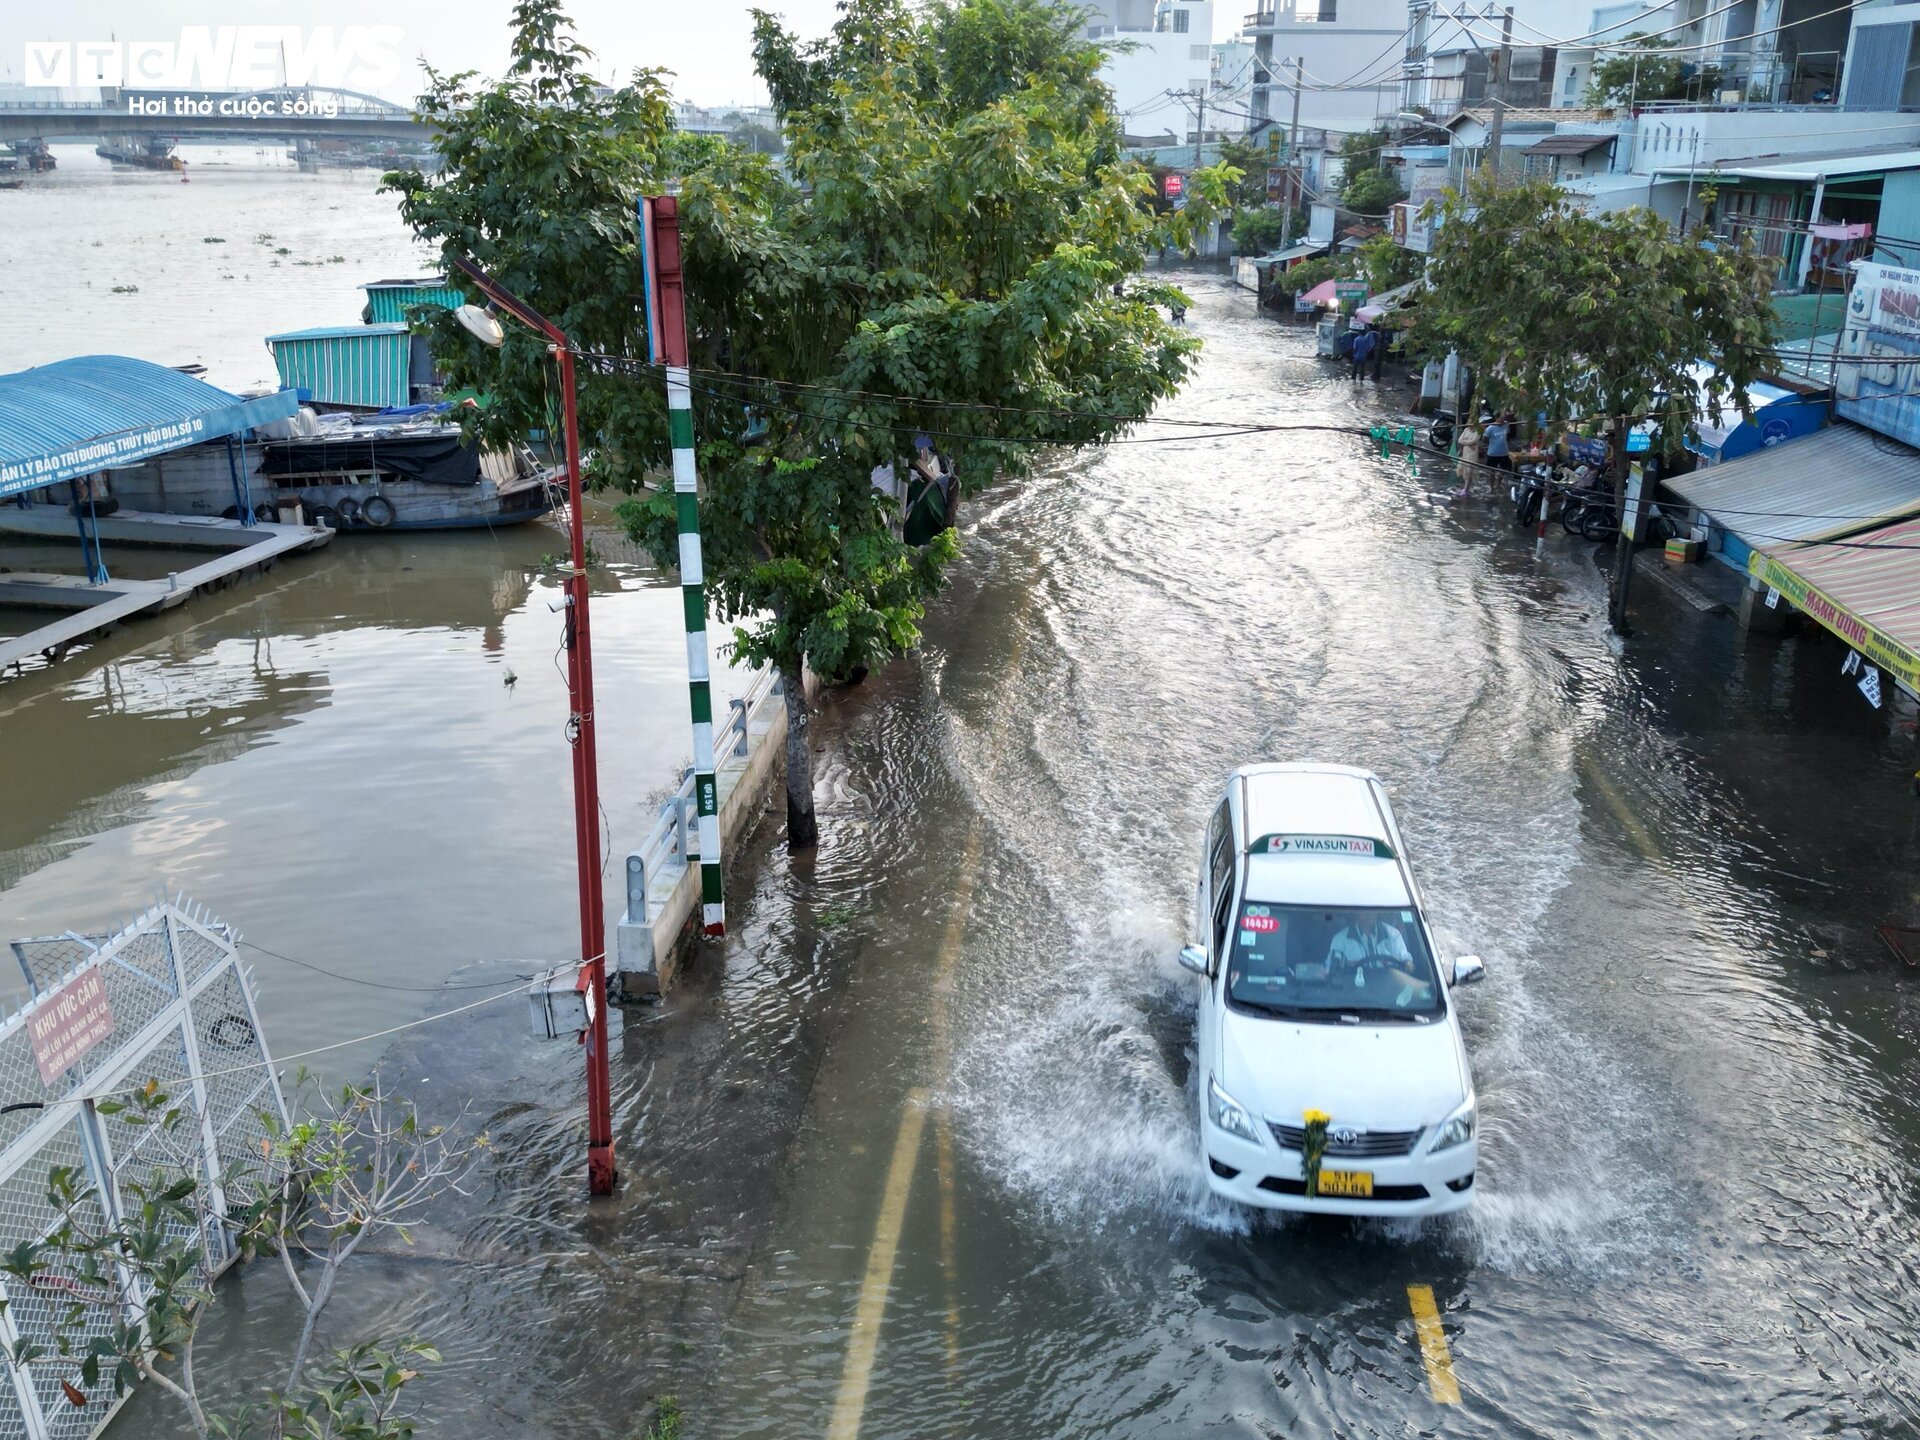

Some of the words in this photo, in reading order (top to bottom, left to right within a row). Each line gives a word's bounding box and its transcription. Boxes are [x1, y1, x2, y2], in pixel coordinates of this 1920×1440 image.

[19, 458, 33, 478] LÝ
[34, 453, 59, 474] BẢO
[59, 447, 78, 467] TRÌ
[78, 440, 116, 464] ĐƯỜNG
[117, 433, 142, 451] THỦY
[143, 424, 162, 447] NỘI
[161, 424, 179, 445] ĐỊA
[179, 416, 193, 435] SỐ
[193, 418, 202, 431] 10
[1245, 917, 1275, 931] 14431
[35, 1010, 56, 1041] KHU
[57, 994, 77, 1021] VỰC
[78, 976, 99, 1006] CẤM
